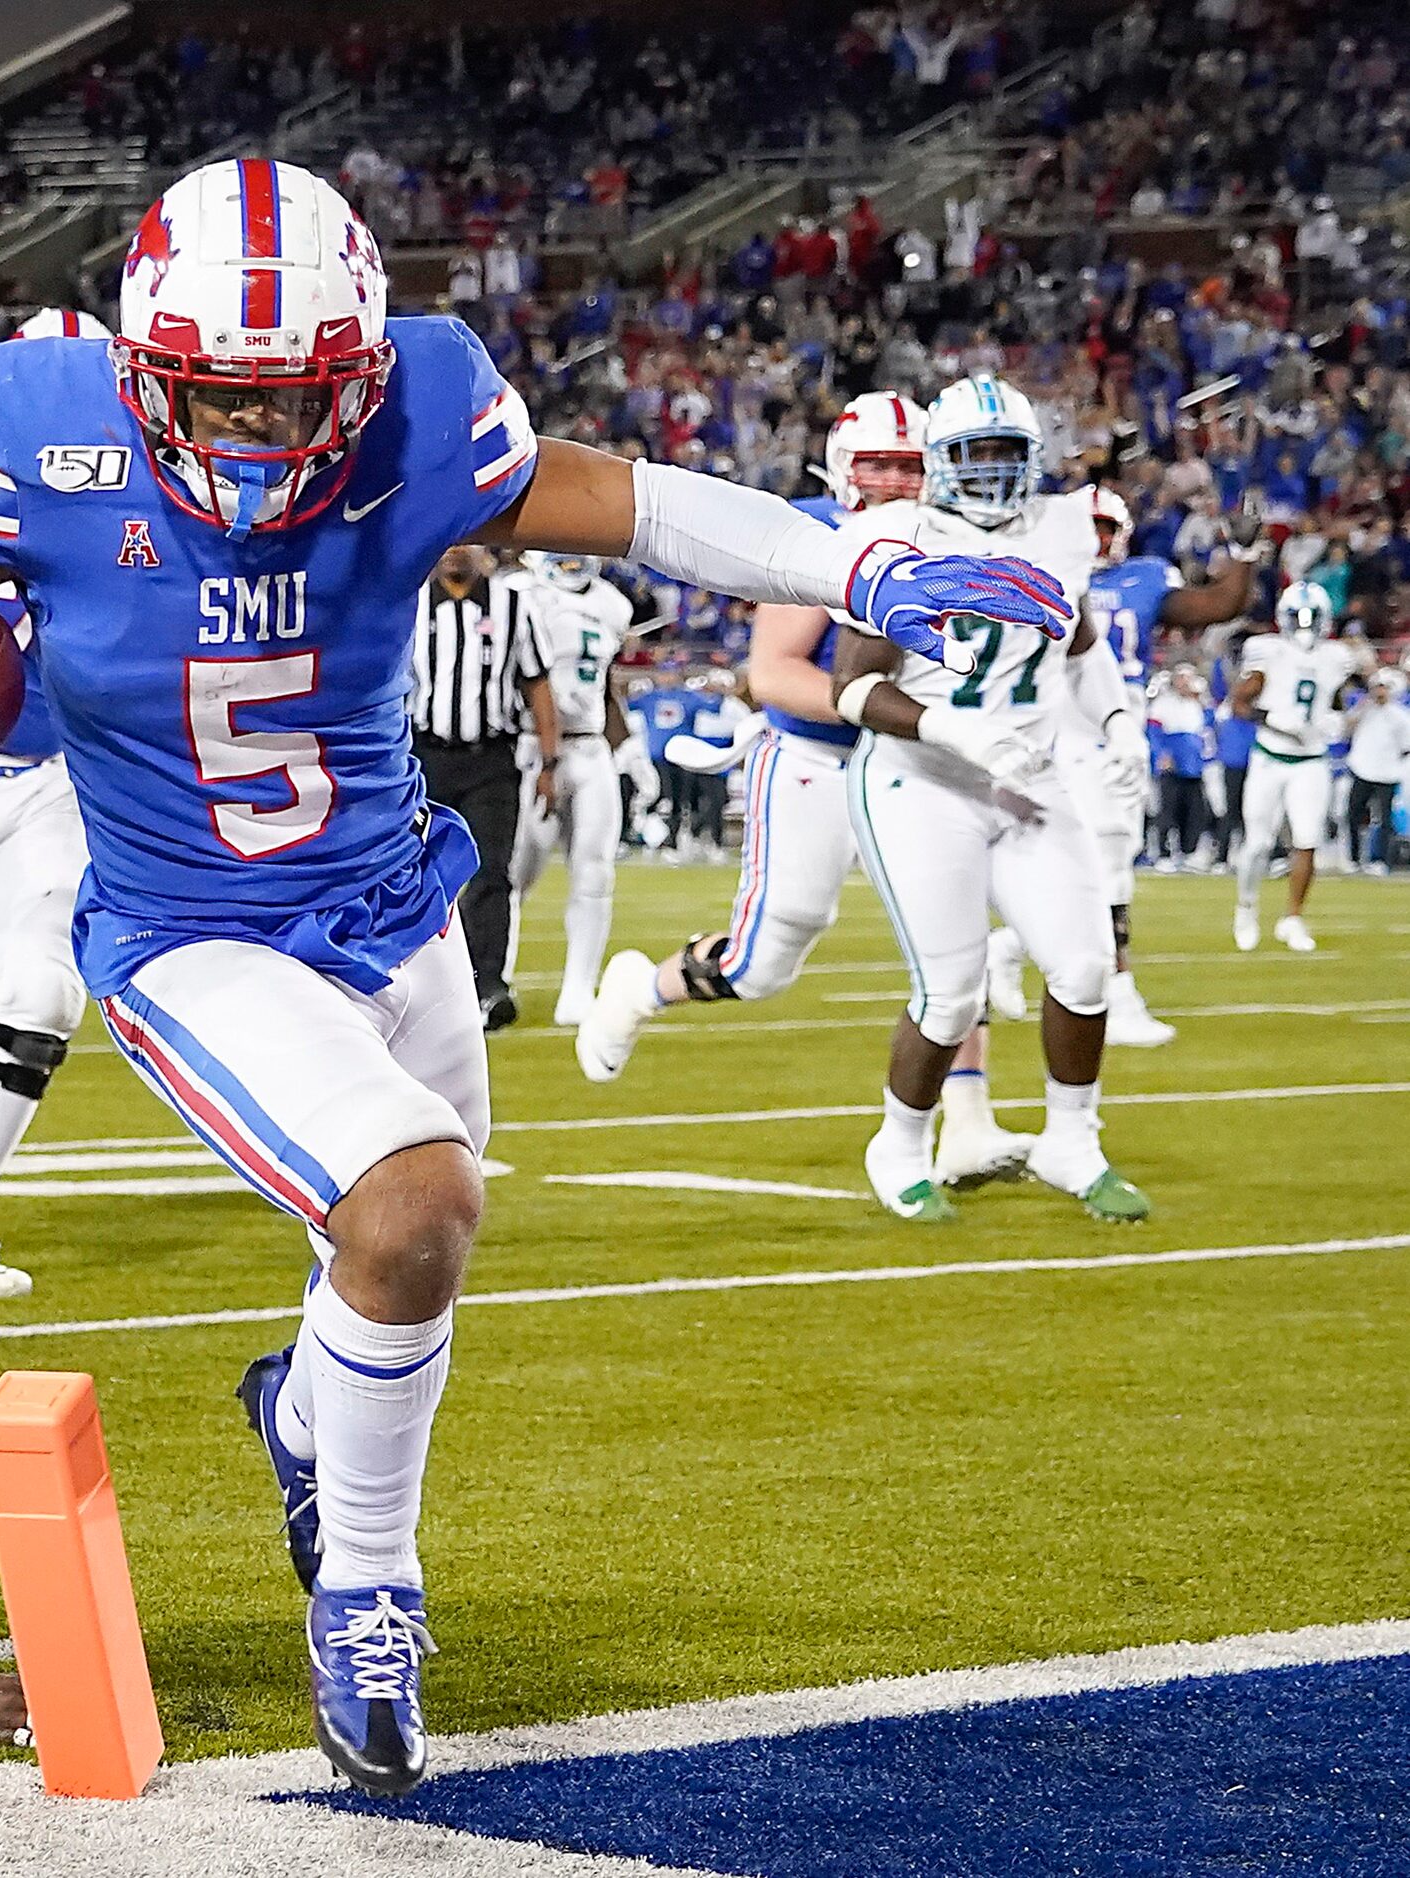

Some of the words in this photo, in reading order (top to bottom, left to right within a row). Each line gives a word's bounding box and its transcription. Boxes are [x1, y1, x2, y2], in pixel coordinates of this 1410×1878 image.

[245, 336, 271, 346] SMU
[38, 446, 131, 491] 150
[198, 571, 307, 644] SMU
[1296, 680, 1317, 721] 9
[183, 648, 338, 861] 5
